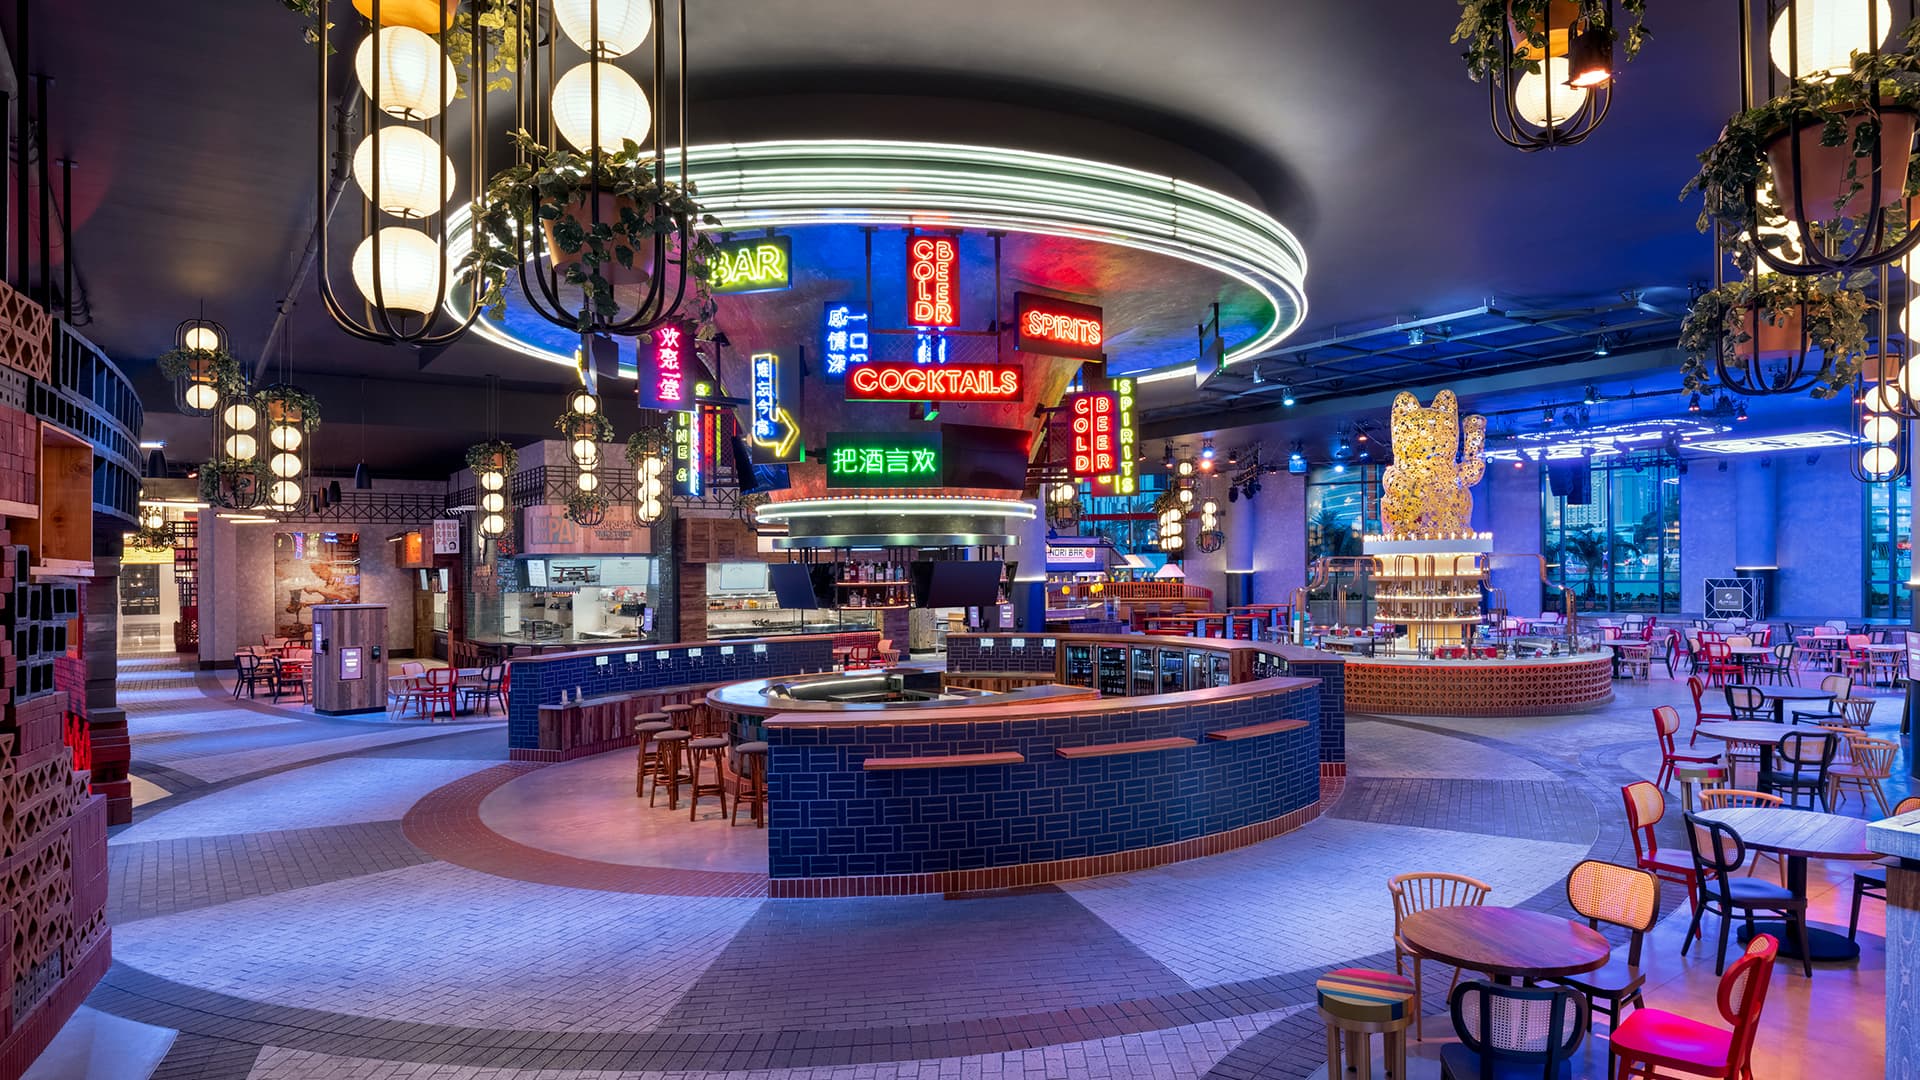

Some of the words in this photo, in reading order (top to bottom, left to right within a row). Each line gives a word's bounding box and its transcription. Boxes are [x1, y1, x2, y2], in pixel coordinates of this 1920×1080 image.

[706, 245, 783, 285] BAR
[913, 240, 934, 322] COLD
[936, 241, 954, 323] BEER
[1028, 310, 1101, 345] SPIRITS
[853, 367, 1018, 394] COCKTAILS
[832, 447, 937, 474] 把酒言欢
[1073, 398, 1090, 472] COLD
[1095, 396, 1110, 470] BEER
[1119, 379, 1134, 494] SPIRITS
[1049, 548, 1067, 557] NORI
[1068, 548, 1084, 557] BAR
